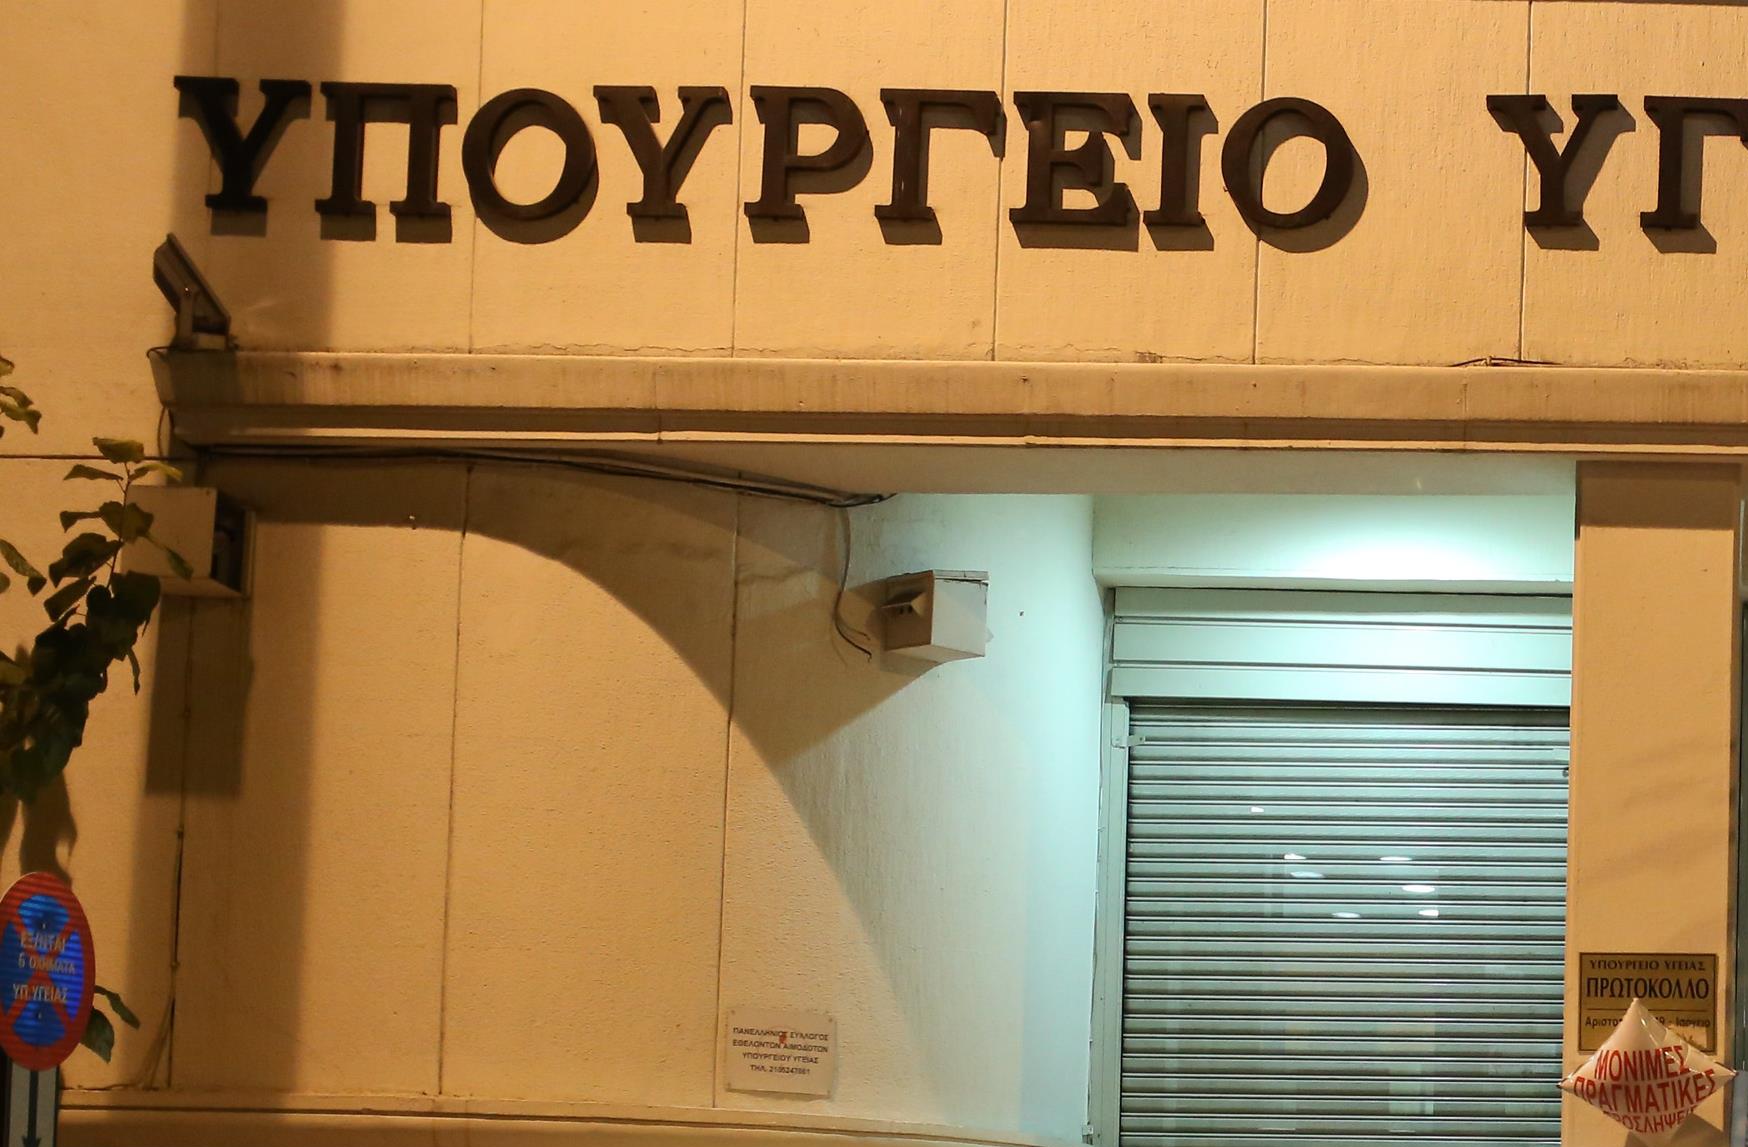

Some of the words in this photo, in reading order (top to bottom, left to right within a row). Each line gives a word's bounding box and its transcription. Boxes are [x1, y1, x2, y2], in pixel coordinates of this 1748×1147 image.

[174, 75, 1356, 229] ΥΠΟΥΡΓΕΙΟ
[1590, 959, 1660, 971] ΥΠΟΥΡΓΕΙΟ
[1664, 960, 1706, 971] ΥΓΕΙΑΣ
[1586, 977, 1709, 999] ΠΡΩΤΟΚΟΛΛΟ
[1594, 1045, 1690, 1082] ΜΟΝΙΜΕΣ
[1574, 1068, 1715, 1113] ΠΡΑΓΜΑΤΙΚΕΣ
